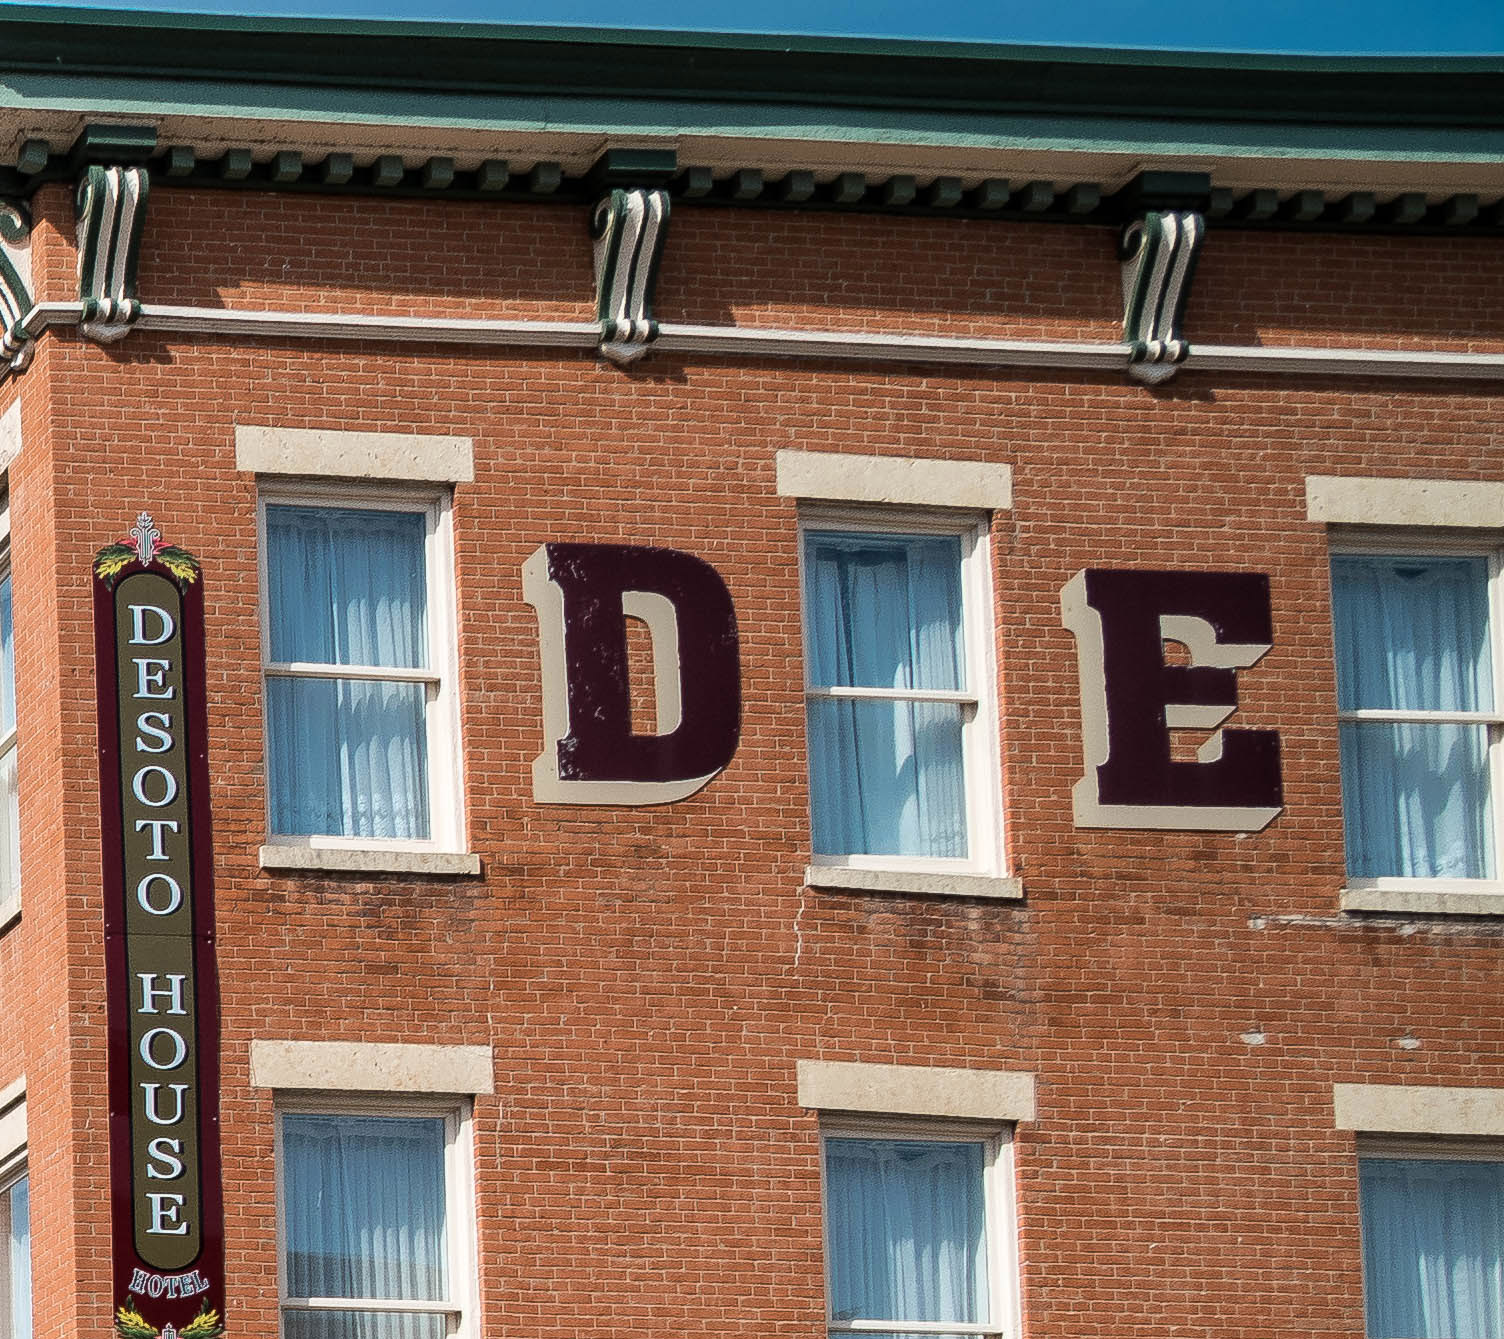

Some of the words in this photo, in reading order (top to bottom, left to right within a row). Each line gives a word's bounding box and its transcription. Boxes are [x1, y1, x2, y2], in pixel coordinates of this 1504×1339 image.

[128, 603, 184, 916] DESOTO
[136, 972, 189, 1237] HOUSE
[129, 1267, 211, 1301] HOTEL
